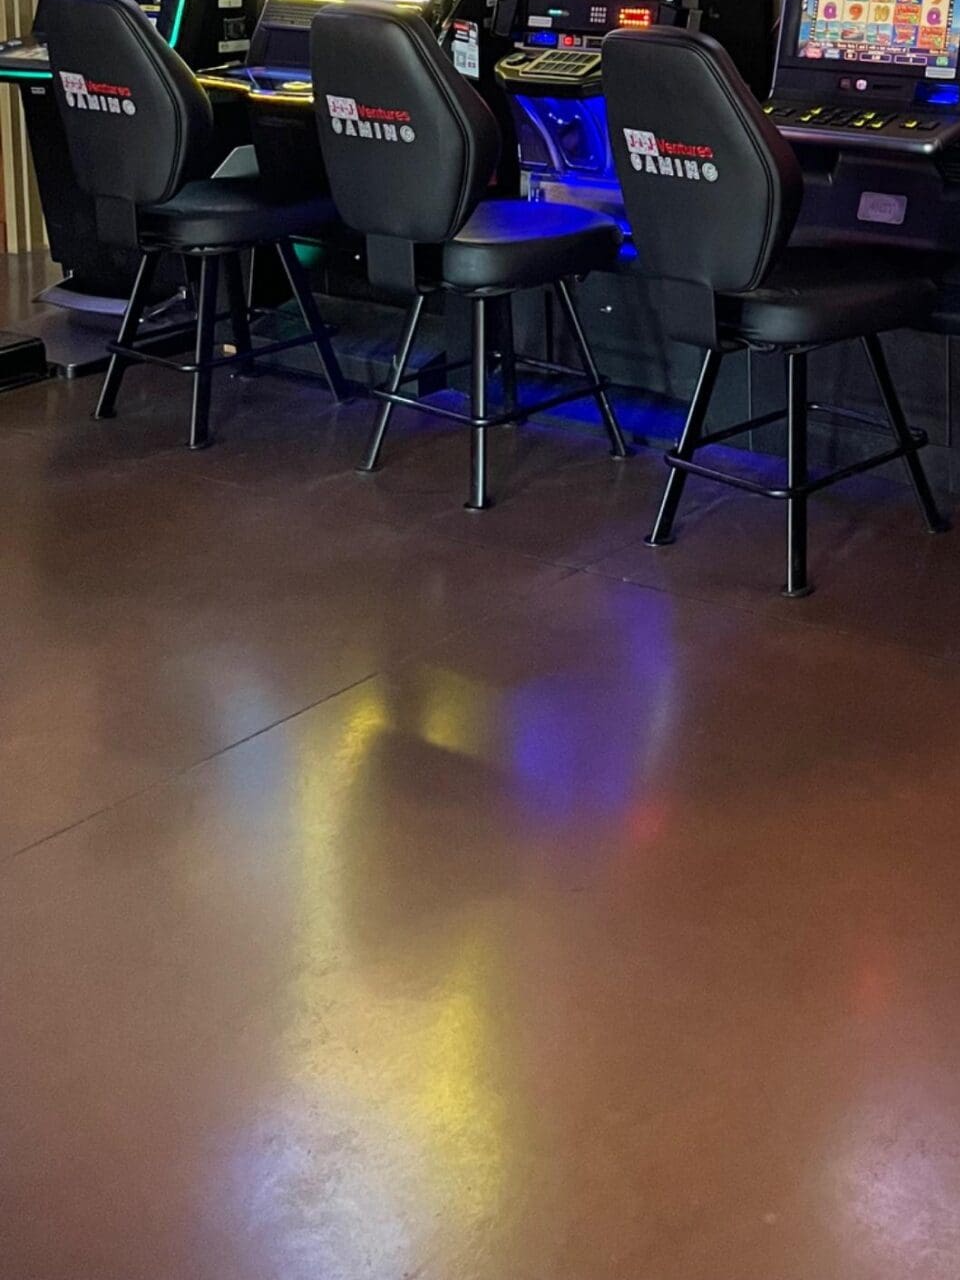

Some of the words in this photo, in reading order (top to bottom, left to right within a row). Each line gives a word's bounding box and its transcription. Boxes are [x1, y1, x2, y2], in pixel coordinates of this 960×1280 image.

[356, 103, 411, 123] Ventures
[331, 117, 416, 144] GAMING
[656, 138, 714, 159] Ventures
[630, 152, 719, 183] GAMING
